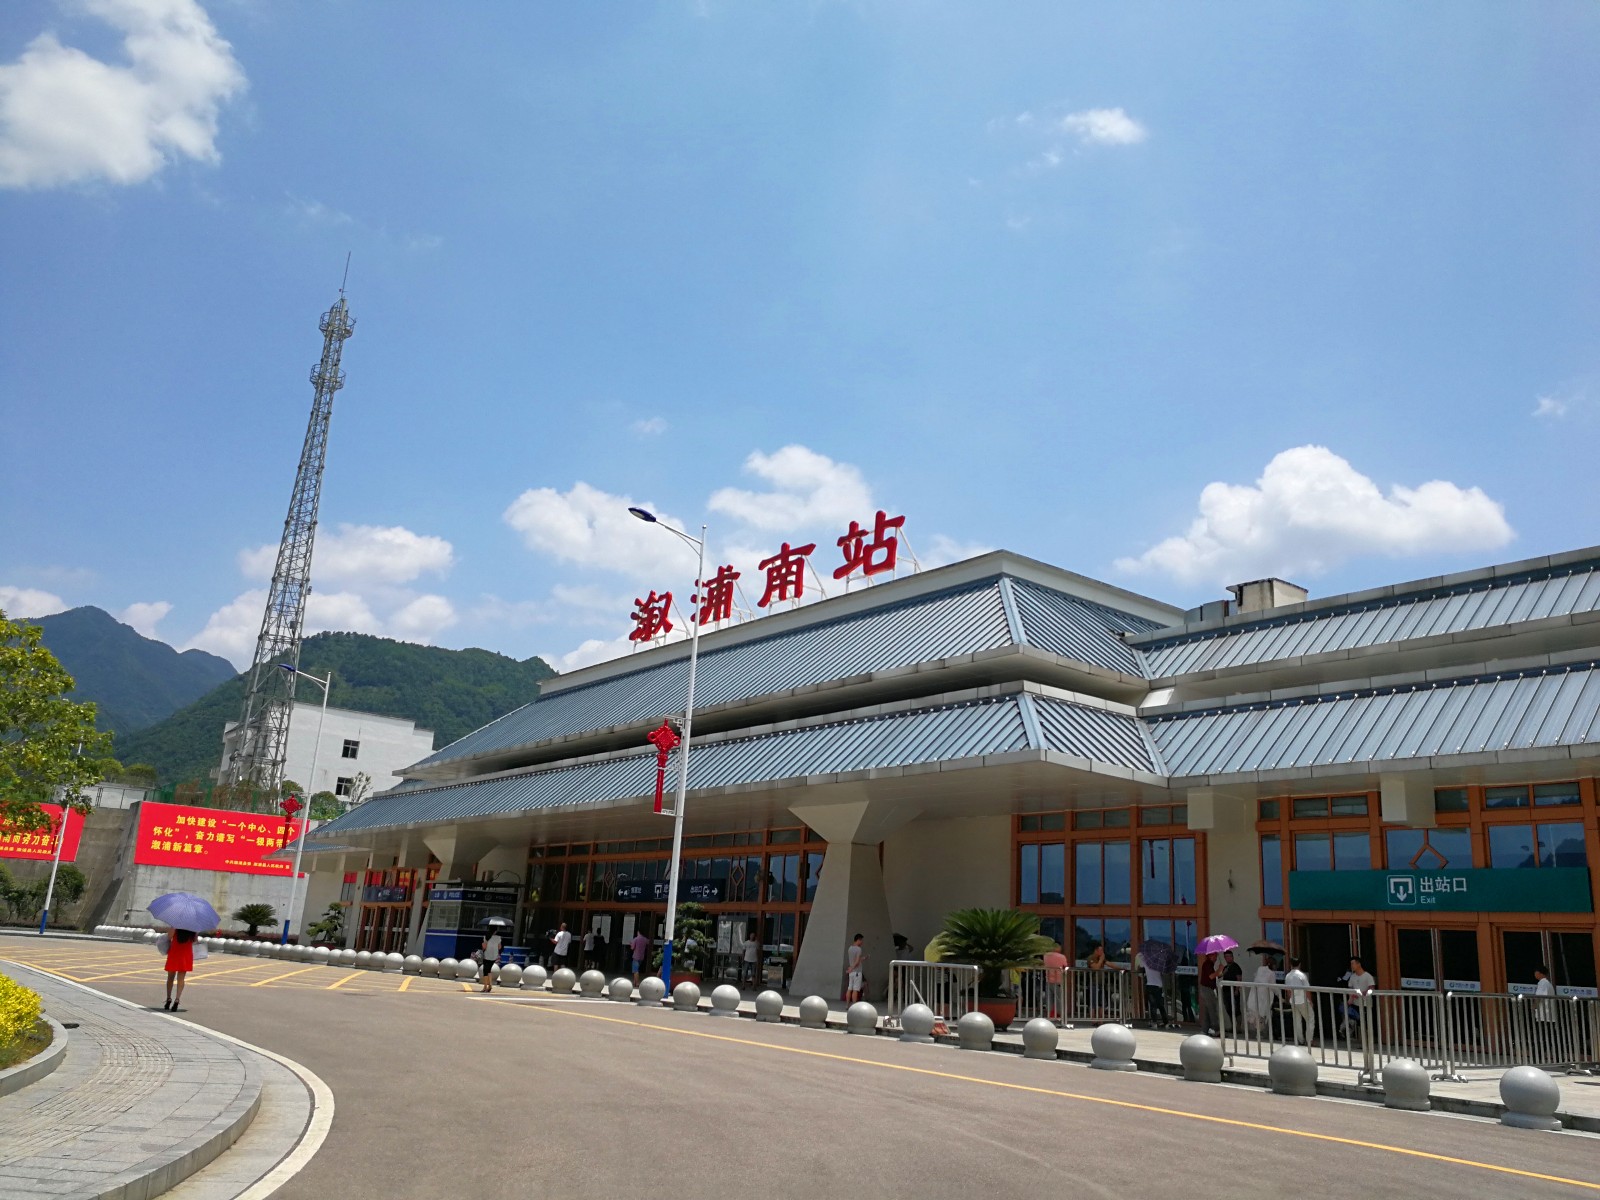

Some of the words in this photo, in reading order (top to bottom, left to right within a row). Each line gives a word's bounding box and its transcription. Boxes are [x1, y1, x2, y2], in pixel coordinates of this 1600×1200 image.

[628, 510, 906, 642] 溆浦南站
[1420, 876, 1468, 893] 出站口
[1420, 895, 1436, 904] Exit
